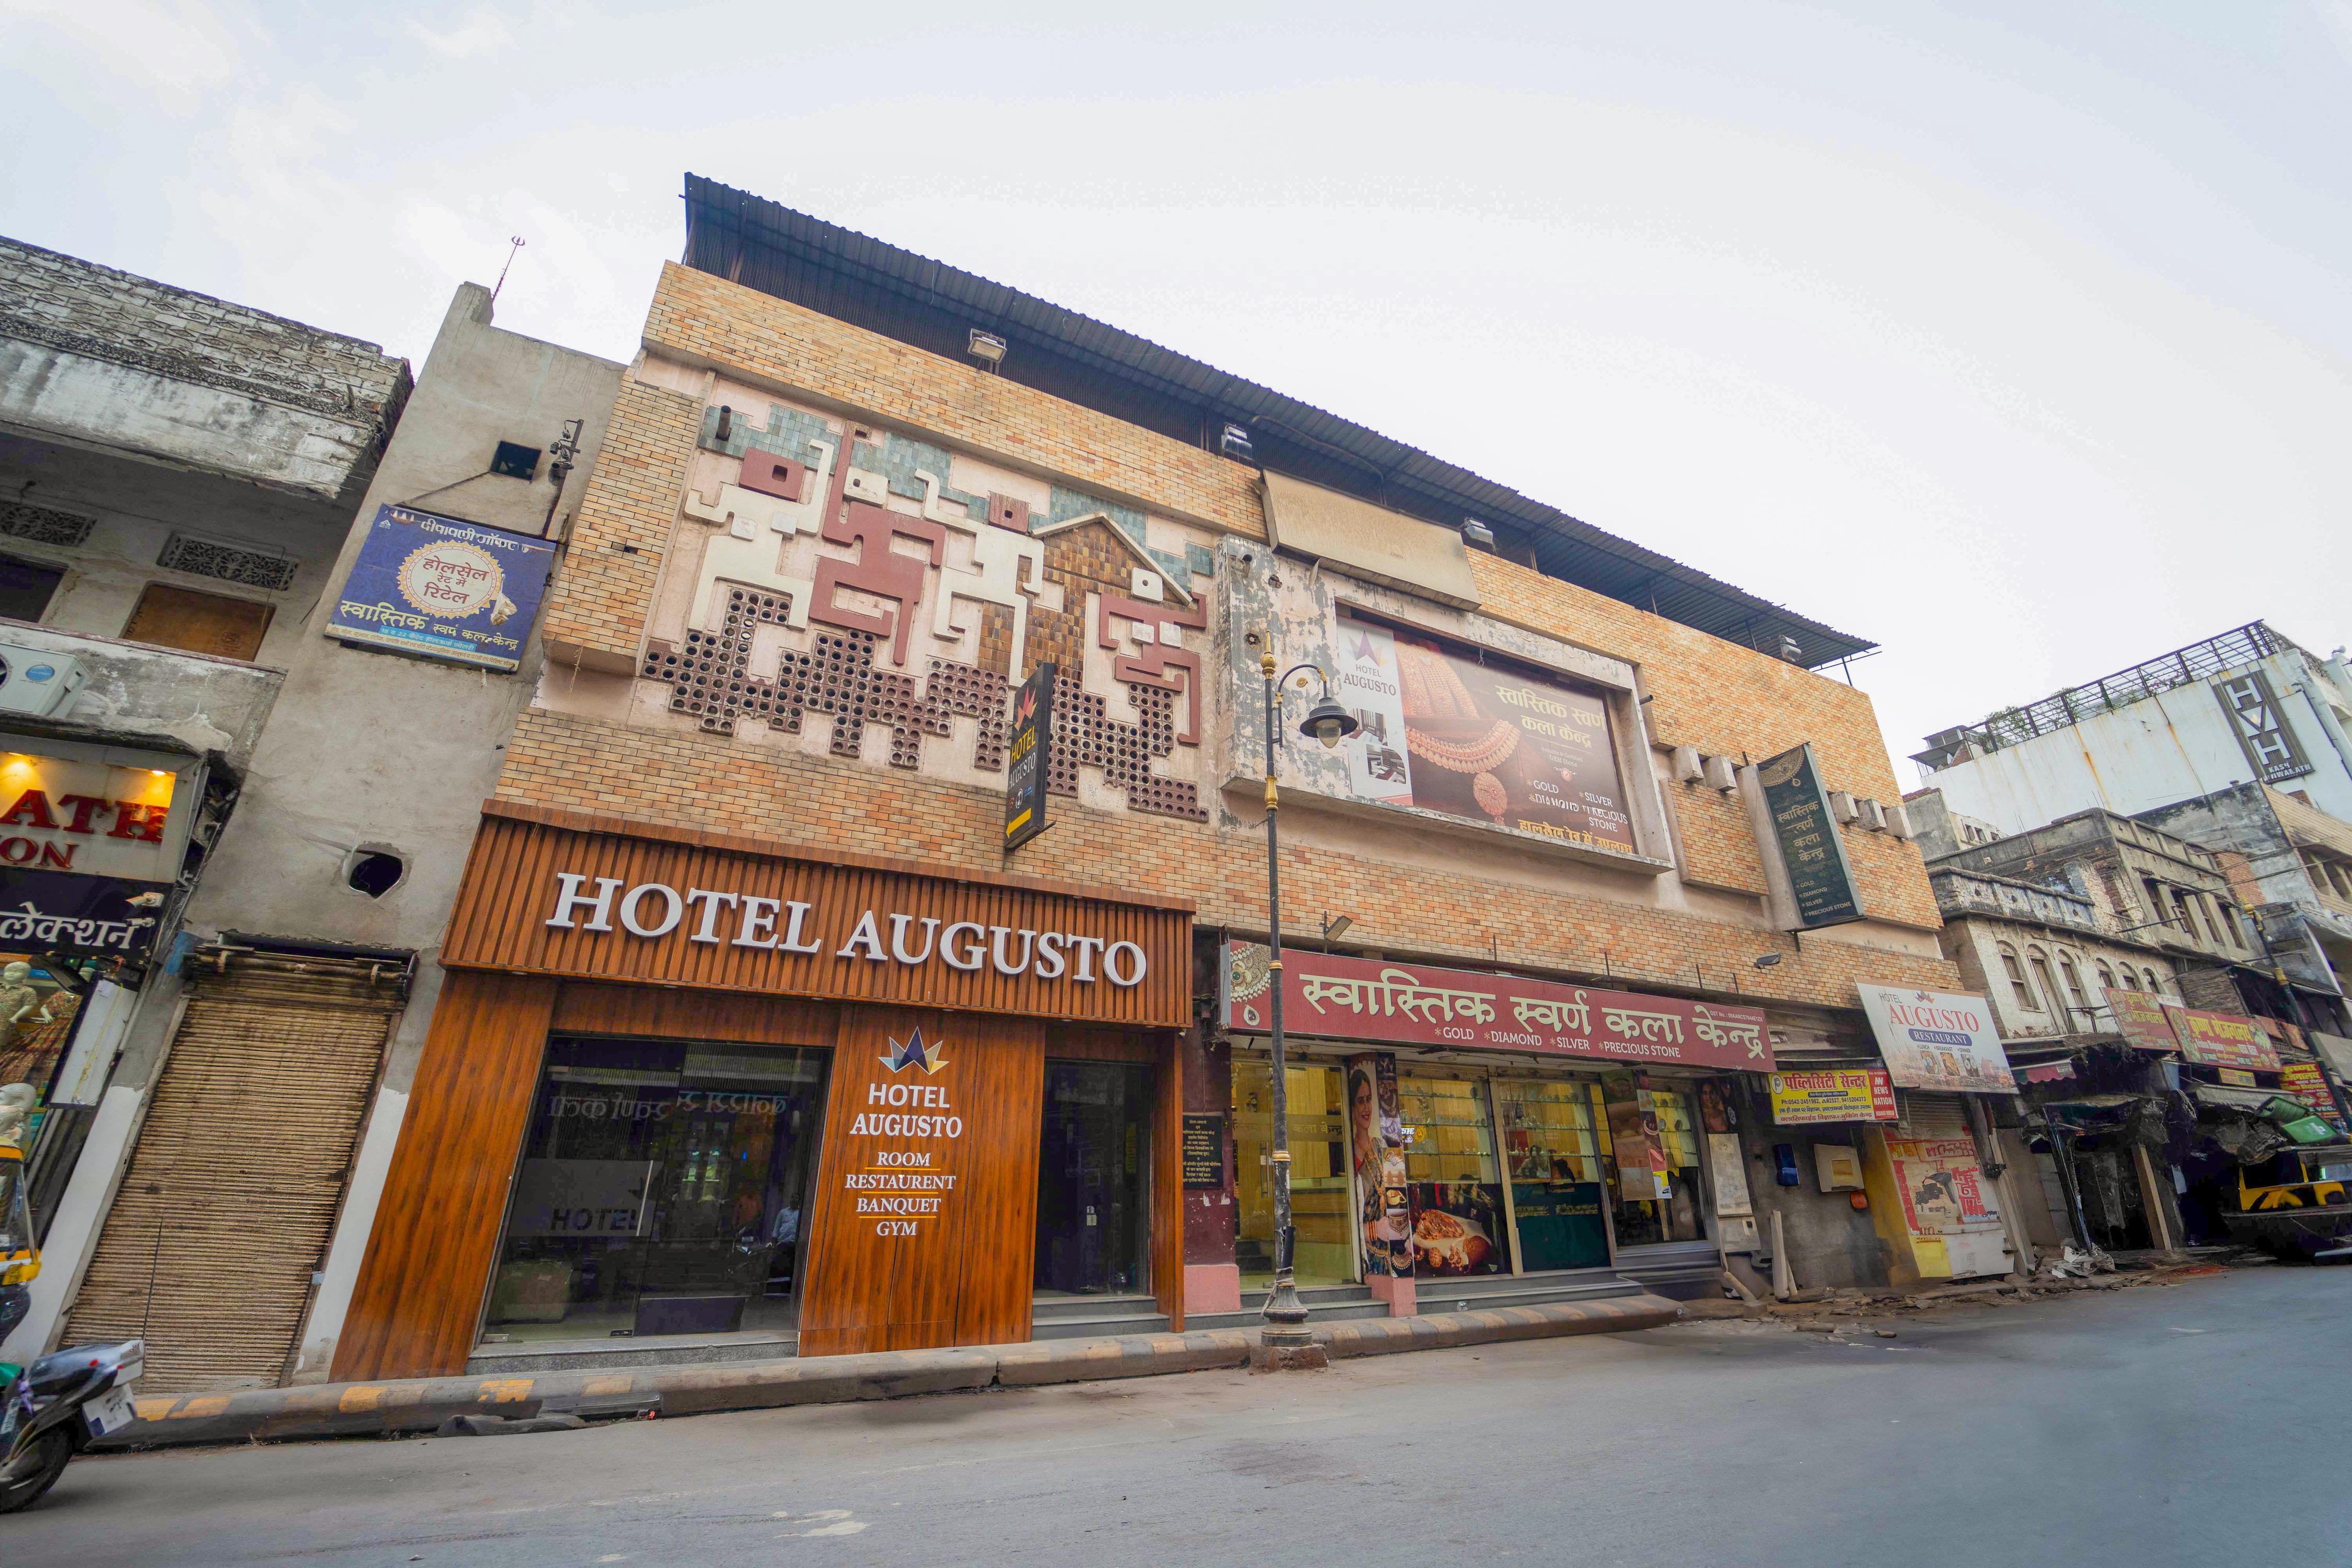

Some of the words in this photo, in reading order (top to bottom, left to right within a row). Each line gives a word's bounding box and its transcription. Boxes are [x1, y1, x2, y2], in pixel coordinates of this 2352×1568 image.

[422, 555, 489, 581] होलसेल
[437, 572, 453, 583] रेट
[455, 577, 467, 587] में
[424, 582, 469, 604] रिटेल
[340, 600, 429, 630] स्वास्तिक
[492, 632, 519, 651] केन्द्र
[1355, 664, 1381, 677] HOTEL
[1343, 673, 1396, 696] AUGUSTO
[1495, 685, 1567, 718] स्वास्तिक
[1521, 715, 1556, 737] कला
[1558, 723, 1592, 748] केन्द्र
[1010, 725, 1036, 766] HOTEL
[1008, 751, 1036, 789] AUGUSTO
[1533, 780, 1559, 793] GOLD
[1585, 792, 1613, 808] SILVER
[0, 789, 168, 844] ATH
[1777, 801, 1819, 823] स्वास्तिक
[1589, 817, 1618, 832] STONE
[1793, 833, 1820, 847] कला
[1798, 847, 1825, 862] केन्द्र
[1803, 887, 1827, 897] DIAMOND
[1806, 898, 1823, 907] SILVER
[1808, 906, 1834, 916] PRECIOUS
[1834, 902, 1852, 910] STONE
[545, 872, 822, 954] HOTEL
[836, 909, 1147, 987] AUGUSTO
[1879, 993, 1903, 1004] HOTEL
[1299, 968, 1496, 1025] स्वास्तिक
[1510, 990, 1592, 1035] स्वर्ण
[1602, 1007, 1685, 1044] कला
[1692, 1005, 1766, 1059] केन्द्र
[1889, 1004, 1980, 1032] AUGUSTO
[1443, 1027, 1474, 1040] GOLD
[1491, 1031, 1542, 1046] DIAMOND
[1558, 1037, 1590, 1051] SILVER
[1604, 1041, 1649, 1055] PRECIOUS
[1651, 1046, 1681, 1057] STONE
[1913, 1031, 1968, 1044] RESTAURANT
[1783, 1073, 1836, 1090] पब्लिसिटी
[868, 1083, 950, 1108] HOTEL
[850, 1113, 962, 1138] AUGUSTO
[877, 1151, 931, 1166] ROOM
[845, 1174, 956, 1189] RESTAURENT
[856, 1198, 941, 1215] BANQUET
[877, 1221, 917, 1236] GYM
